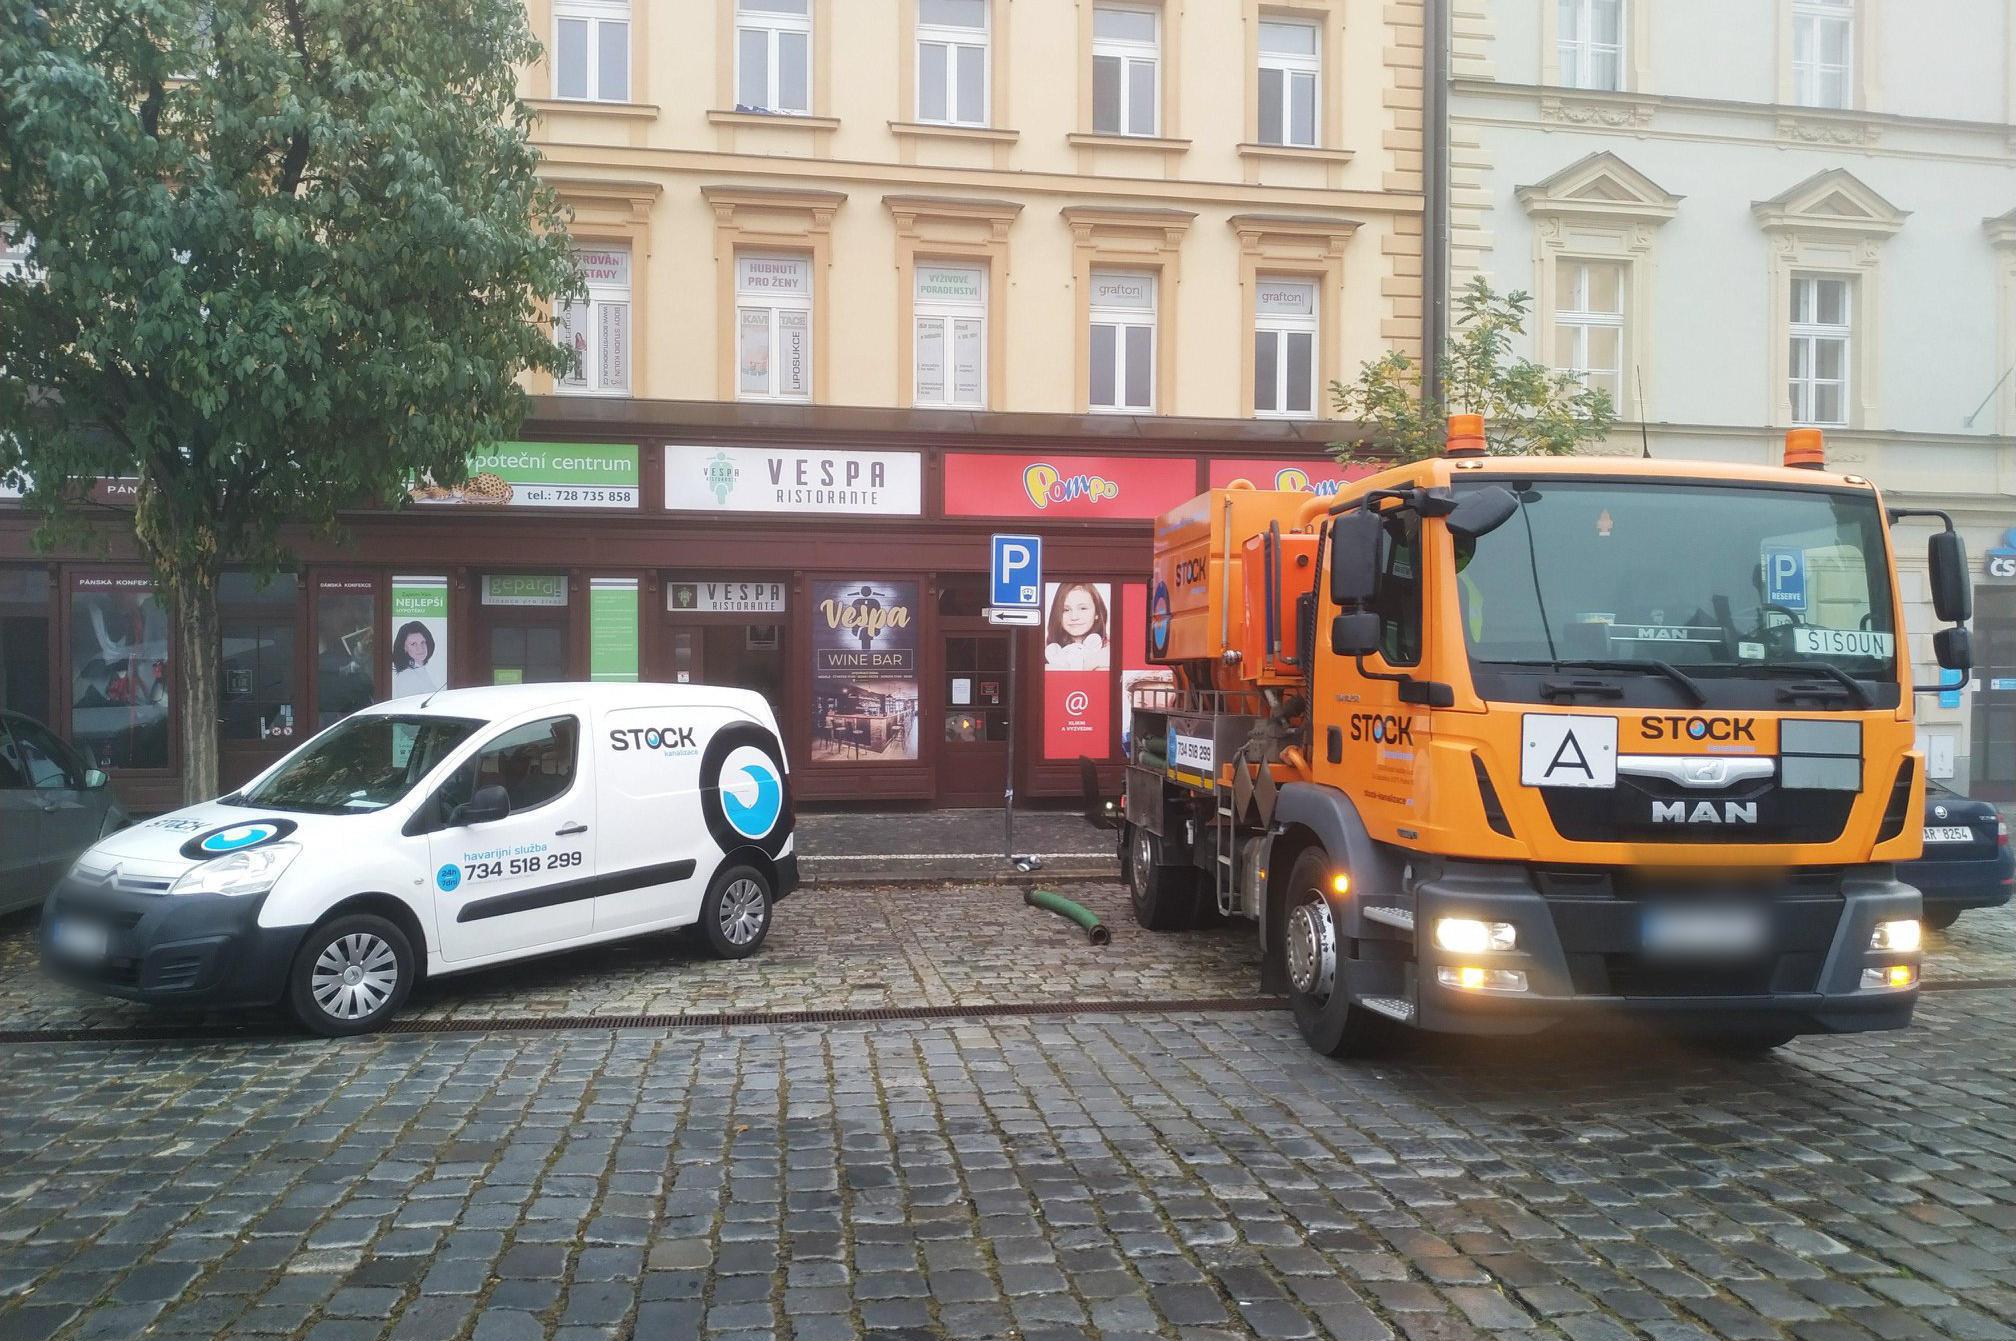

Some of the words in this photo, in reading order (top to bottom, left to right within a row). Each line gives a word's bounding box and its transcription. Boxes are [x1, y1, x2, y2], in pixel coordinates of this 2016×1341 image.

[582, 254, 624, 266] ROVÁNÍ
[750, 263, 797, 275] HUBNUTÍ
[583, 269, 617, 279] STAVY
[748, 276, 769, 287] PRO
[772, 276, 799, 288] ŽENY
[920, 285, 977, 296] PORADENSTVÍ
[1099, 284, 1140, 296] grafton
[1262, 291, 1301, 303] grafton
[792, 331, 801, 390] LIPOSUKCE
[464, 451, 546, 472] ypoteční
[551, 455, 632, 472] centrum
[703, 467, 740, 477] VESPA
[767, 458, 885, 488] VESPA
[527, 490, 552, 501] tel.:
[556, 490, 578, 501] 728
[582, 491, 604, 502] 735
[608, 491, 631, 502] 858
[776, 489, 878, 505] RISTORANTE
[1002, 544, 1030, 584] P
[1176, 555, 1207, 587] STOCK
[1775, 554, 1797, 590] P
[706, 583, 780, 601] VESPA
[396, 596, 444, 608] NEJLEPŠÍ
[712, 601, 776, 611] RISTORANTE
[819, 598, 911, 638] Vespa
[1638, 628, 1688, 639] MAN
[828, 654, 869, 666] WINE
[872, 654, 903, 666] BAR
[1065, 690, 1089, 716] @
[1350, 713, 1414, 747] STOCK
[1639, 715, 1756, 741] STOCK
[609, 726, 697, 751] STOCK
[1177, 742, 1188, 756] 734
[1188, 743, 1199, 759] 518
[1199, 745, 1211, 761] 299
[1544, 728, 1595, 779] A
[1651, 801, 1758, 824] MAN
[1942, 828, 1968, 840] 8254
[463, 847, 511, 862] havarijní
[514, 843, 548, 855] služba
[464, 861, 503, 881] 734
[509, 856, 541, 875] 518
[546, 851, 582, 870] 299
